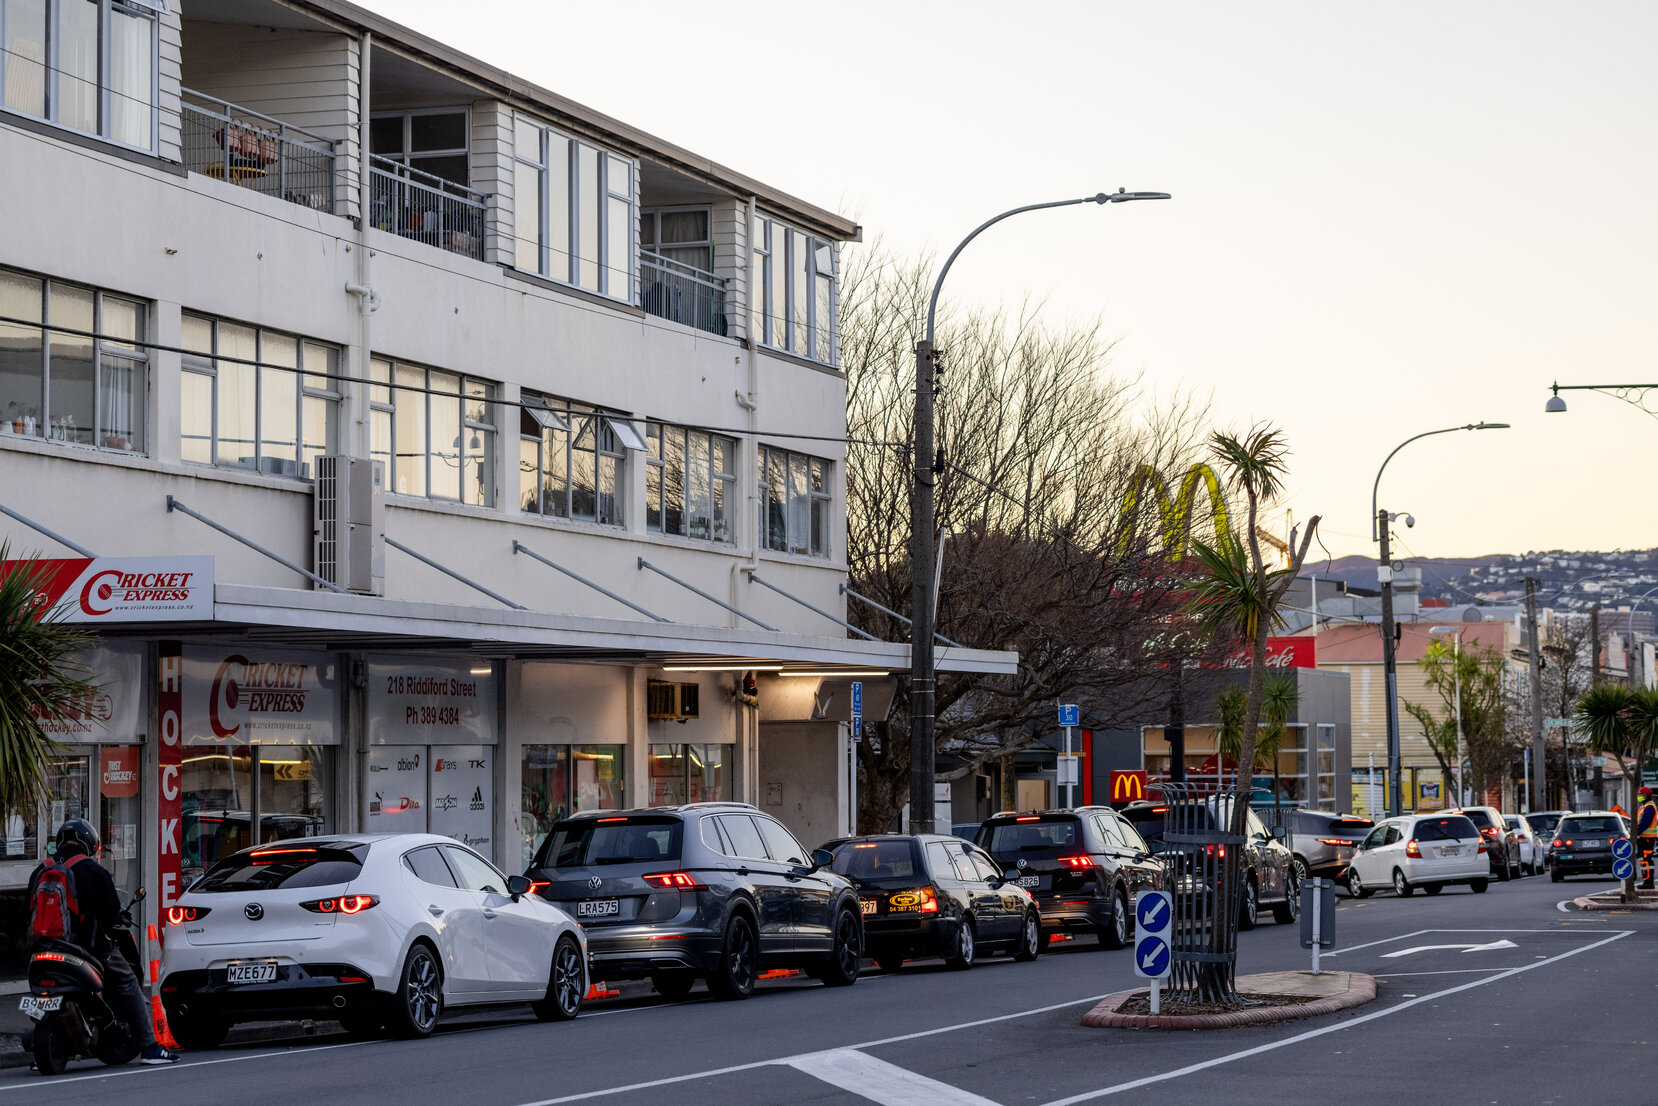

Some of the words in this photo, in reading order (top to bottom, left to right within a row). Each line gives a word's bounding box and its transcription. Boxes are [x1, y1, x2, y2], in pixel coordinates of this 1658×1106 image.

[80, 570, 193, 615] CRICKET
[123, 590, 190, 601] EXPRESS
[1223, 646, 1294, 667] Mcafé
[387, 676, 404, 694] 218
[406, 676, 448, 696] Riddiford
[450, 678, 476, 697] Street
[209, 654, 308, 738] CRICKET
[248, 692, 306, 712] EXPRESS
[406, 706, 418, 724] Ph
[420, 706, 437, 724] 389
[438, 707, 459, 725] 4384
[397, 758, 415, 771] albion
[467, 760, 486, 768] TK
[111, 771, 132, 781] HOCKEY
[161, 656, 179, 934] HOCKE
[470, 802, 485, 811] adidas
[579, 901, 618, 914] LRA575
[228, 966, 275, 980] MZE677
